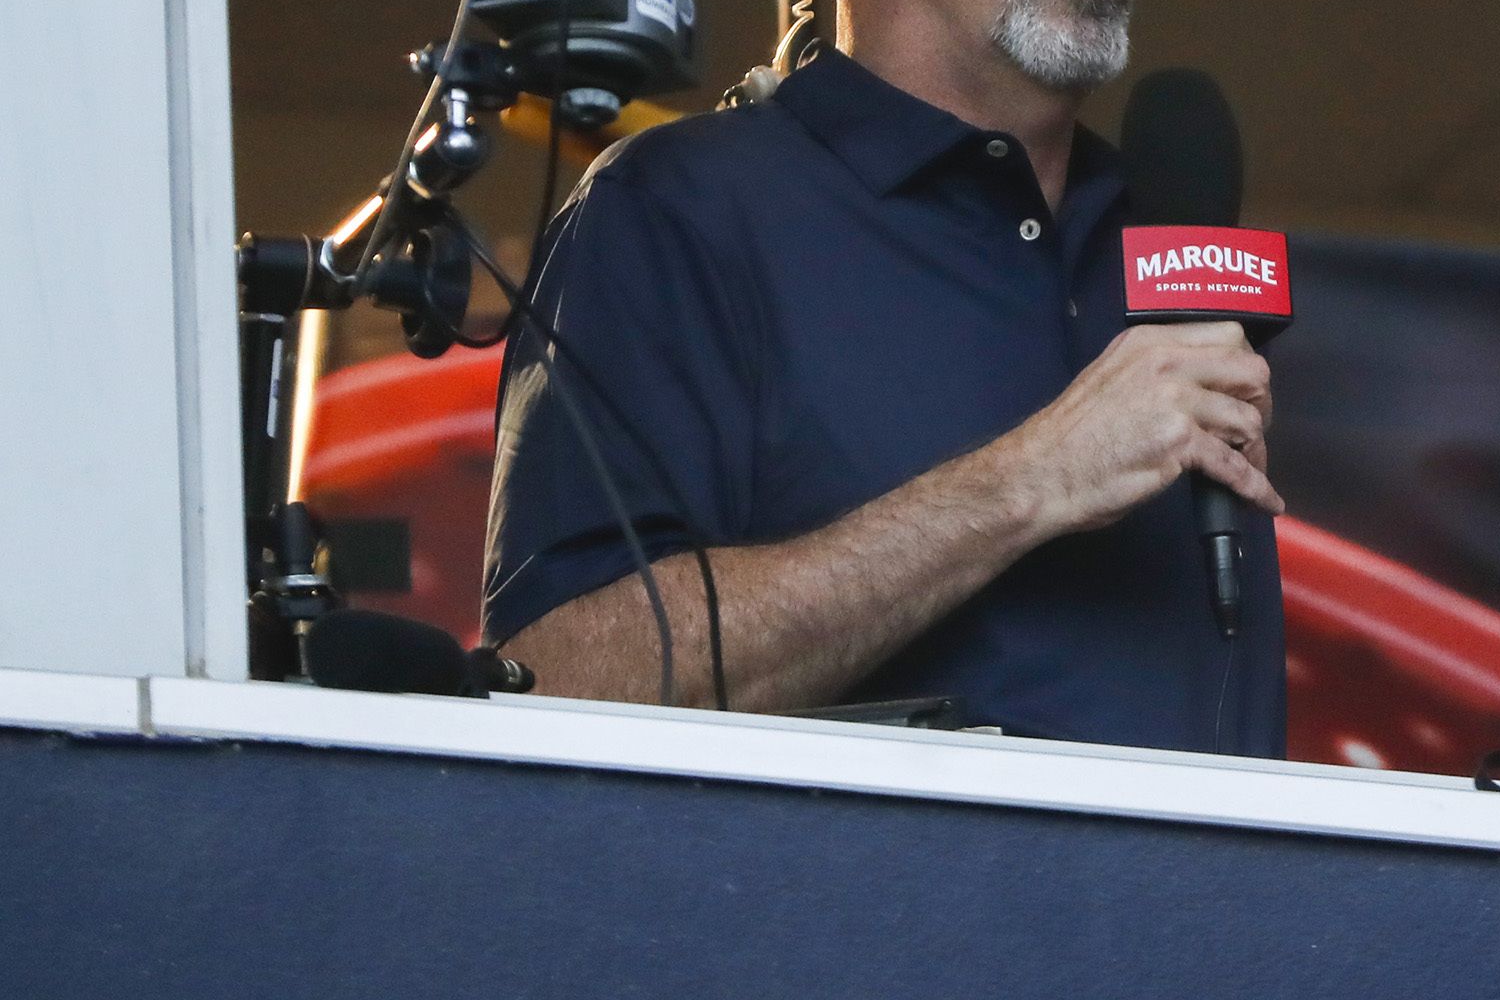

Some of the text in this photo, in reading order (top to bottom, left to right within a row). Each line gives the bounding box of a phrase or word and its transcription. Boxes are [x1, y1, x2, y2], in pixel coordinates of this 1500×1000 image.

[1136, 245, 1277, 284] MARQUEE
[1155, 282, 1262, 295] SPORTS NETWORK
